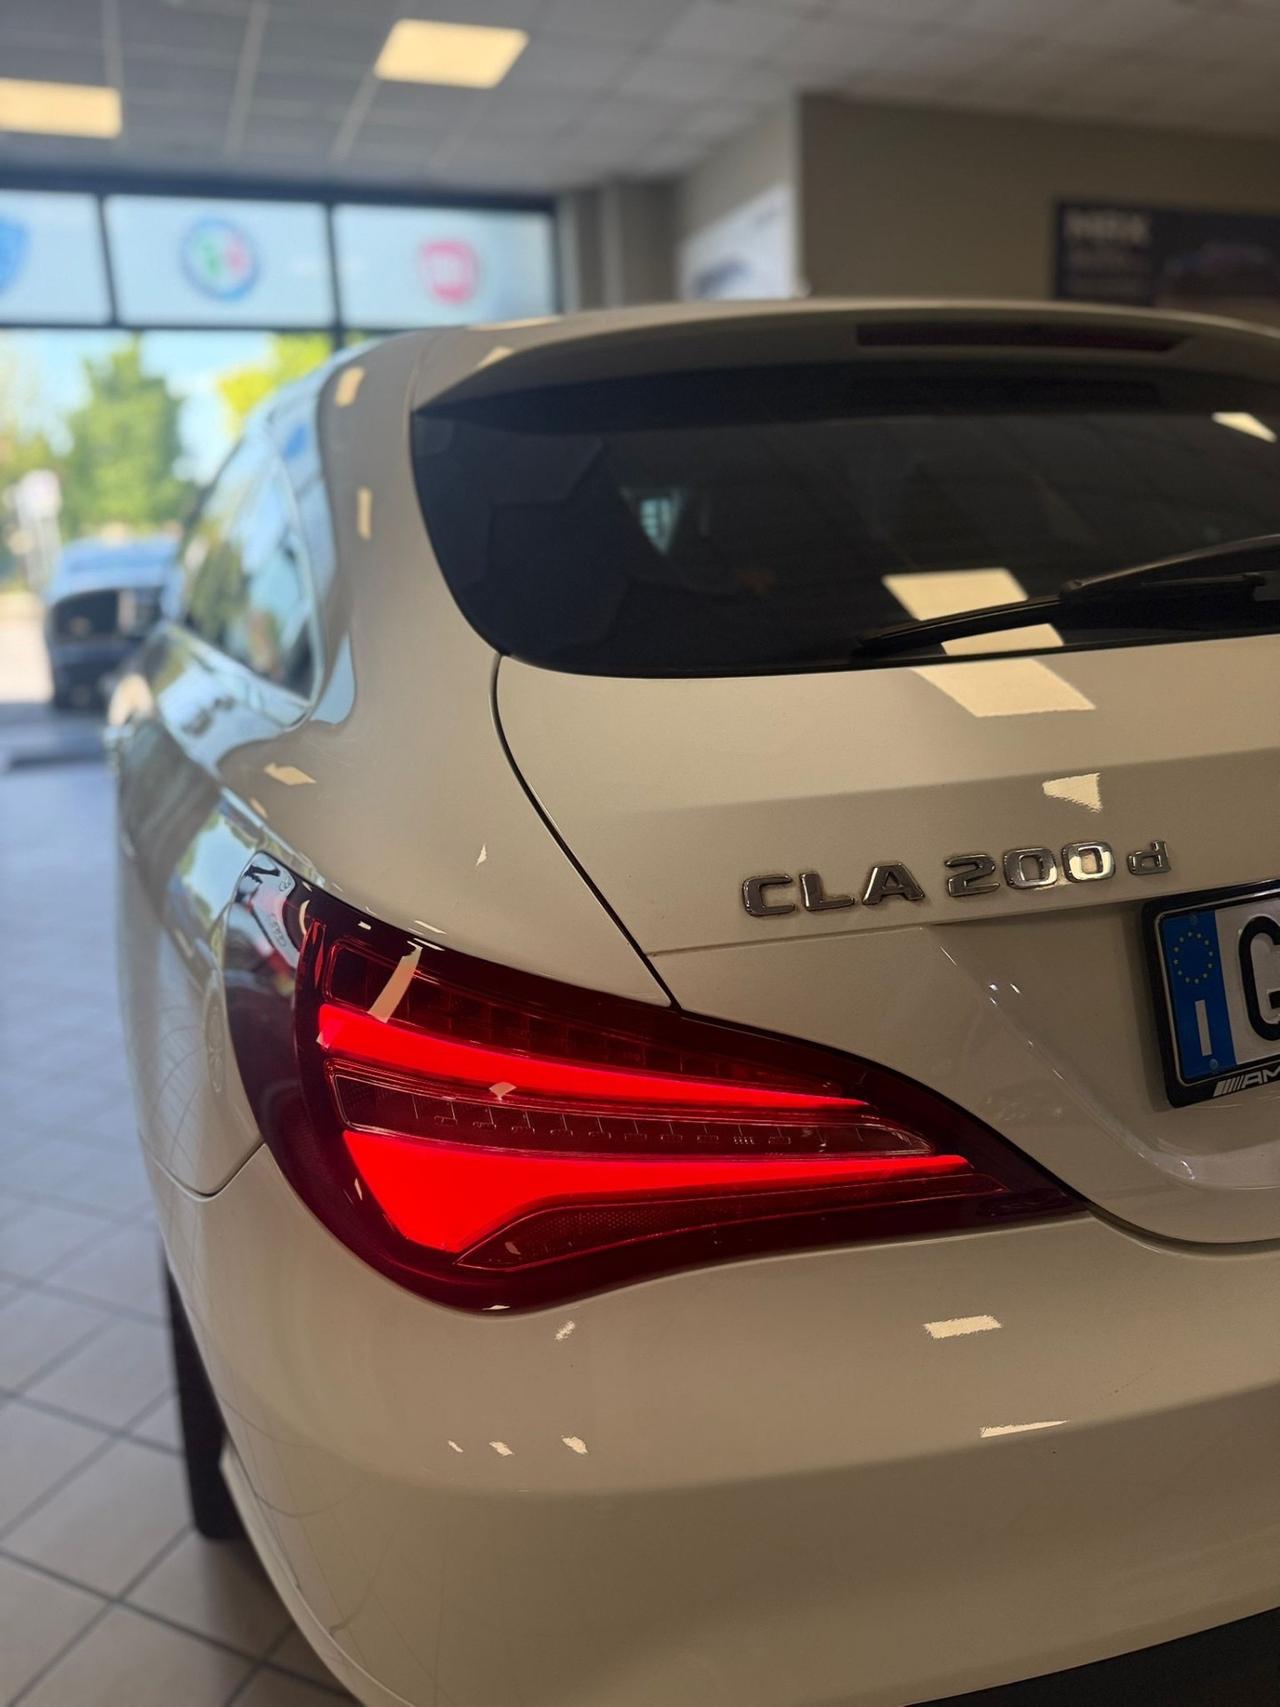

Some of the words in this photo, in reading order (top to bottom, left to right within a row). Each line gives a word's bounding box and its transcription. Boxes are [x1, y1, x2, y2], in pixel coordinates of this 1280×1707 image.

[742, 863, 925, 916] CLA
[945, 840, 1116, 897] 200
[1128, 840, 1171, 875] d
[1238, 915, 1280, 1041] G
[1194, 999, 1213, 1056] I
